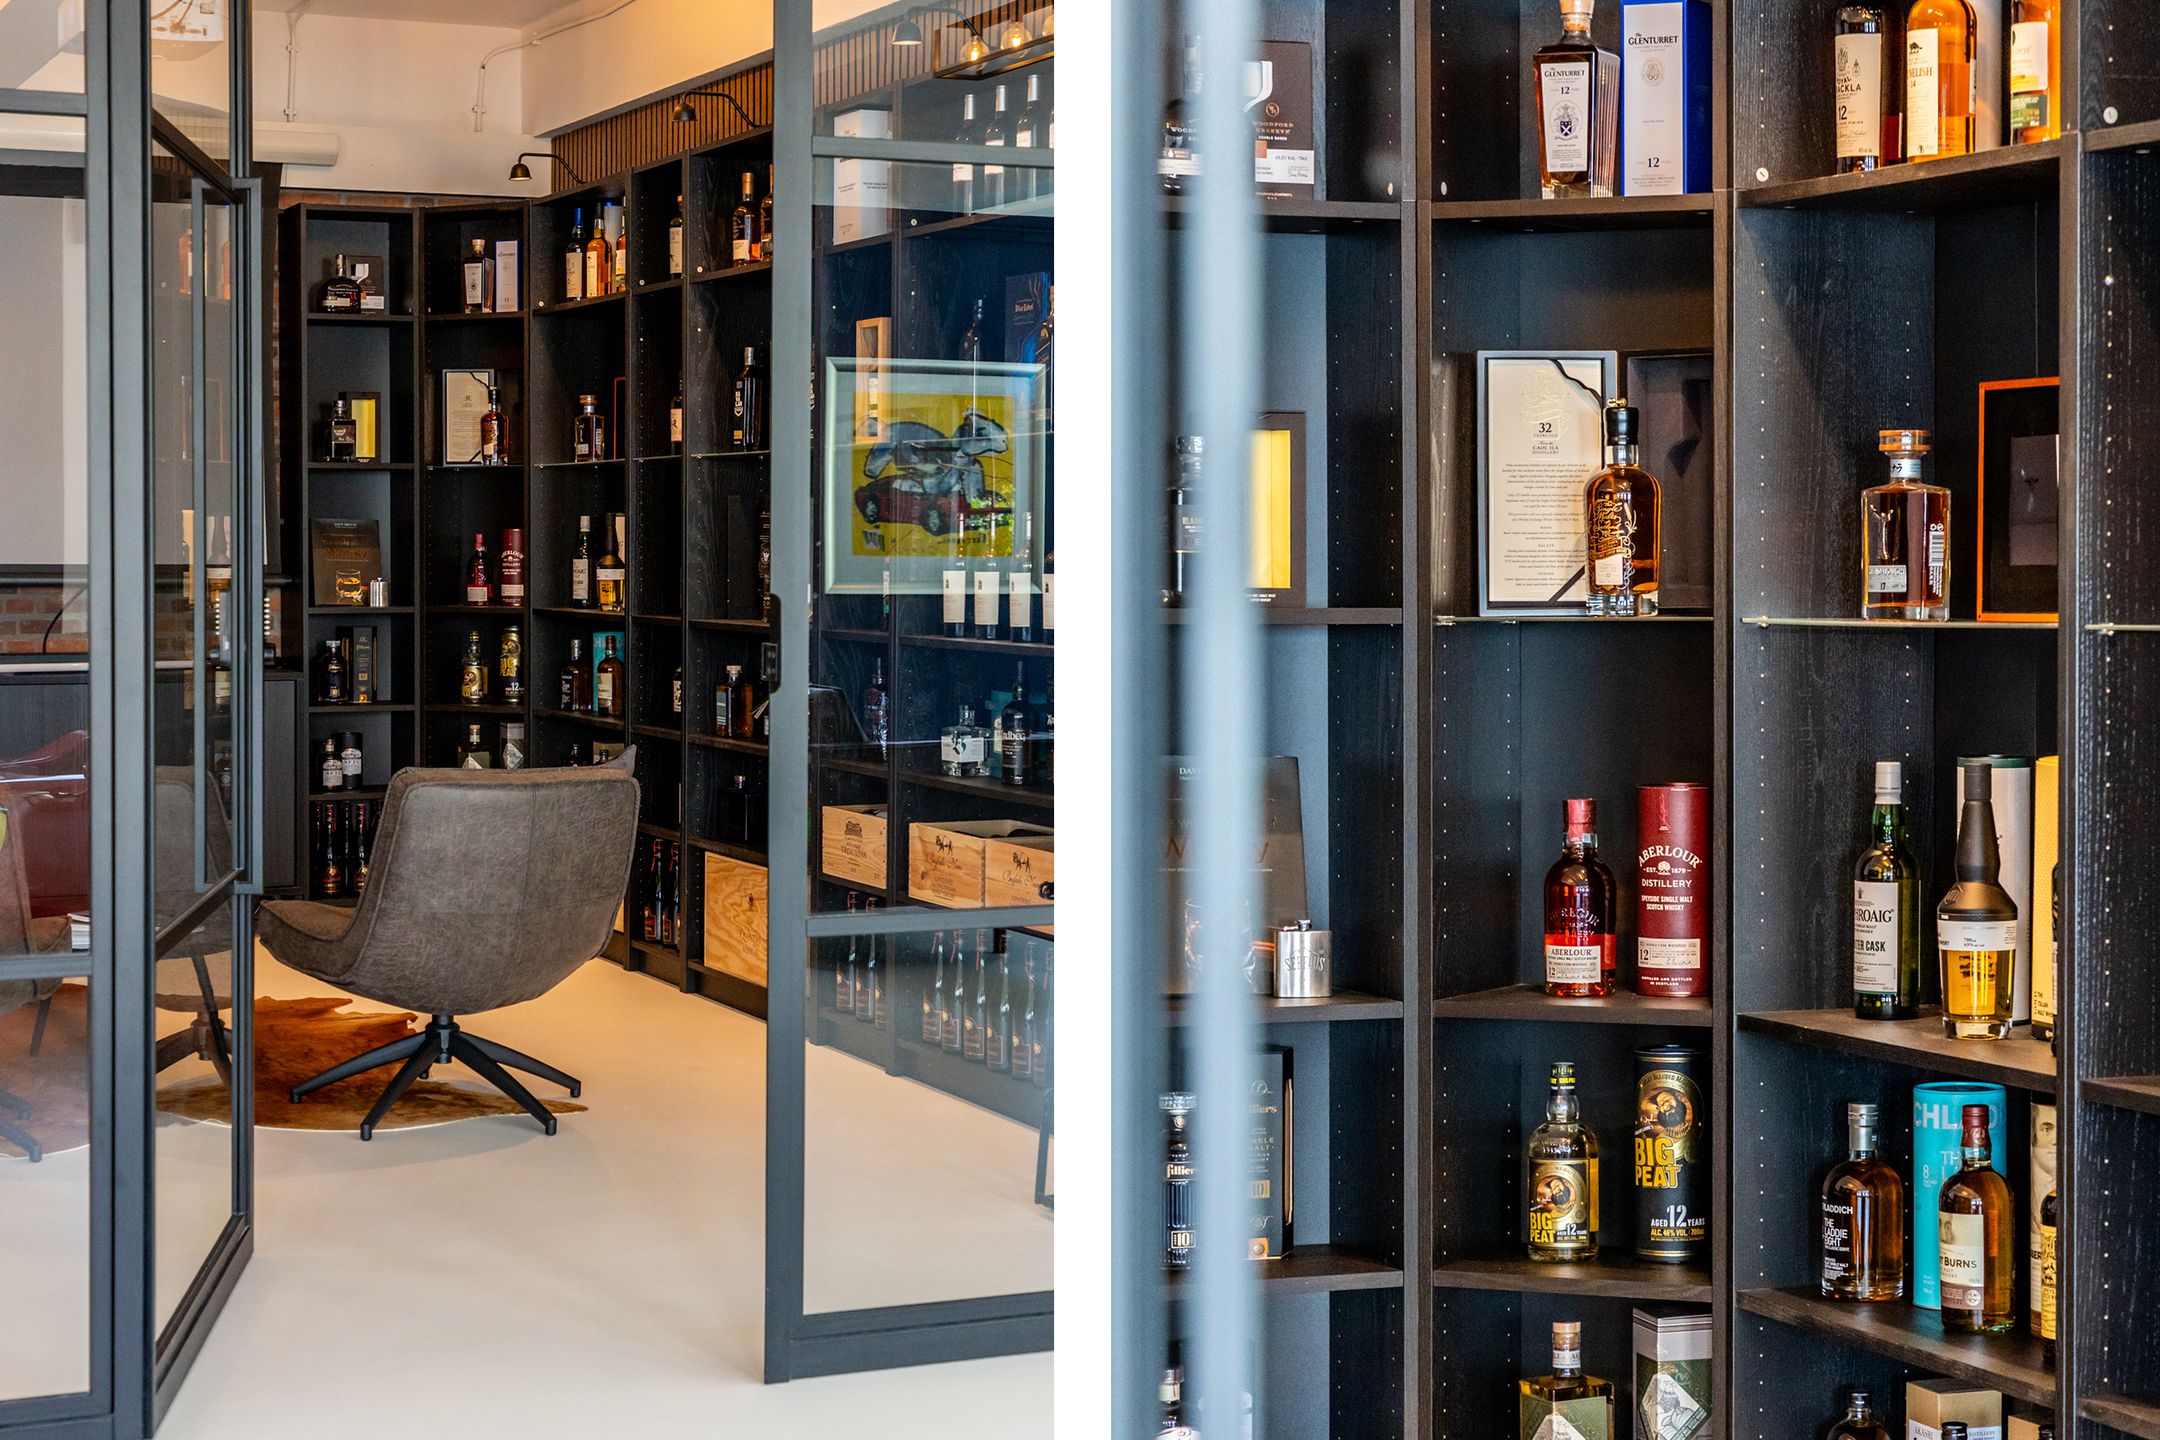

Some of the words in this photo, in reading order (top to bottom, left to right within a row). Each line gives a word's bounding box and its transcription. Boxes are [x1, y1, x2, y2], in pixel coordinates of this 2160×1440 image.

[1628, 35, 1679, 46] GLENTURRET
[1544, 70, 1585, 78] GLENTURRET
[1560, 86, 1570, 95] 12
[1647, 156, 1660, 168] 12
[1538, 422, 1552, 433] 32
[1638, 845, 1700, 869] ABERLOUR
[1641, 878, 1692, 888] DISTILLERY
[1551, 948, 1592, 956] ABERLOUR
[1865, 940, 1886, 952] CASK
[1640, 949, 1649, 961] 12
[1548, 966, 1556, 976] 12
[1635, 1137, 1675, 1167] BIG
[1166, 1164, 1196, 1178] fillier
[1635, 1165, 1680, 1188] PEAT
[1922, 1164, 1930, 1179] 8
[1530, 1212, 1553, 1230] BIG
[1651, 1218, 1668, 1227] AGED
[1667, 1204, 1687, 1228] 12
[1687, 1217, 1705, 1227] YEARS
[1824, 1217, 1834, 1228] THE
[1565, 1223, 1577, 1236] 12
[1651, 1228, 1663, 1237] ALC.
[1676, 1228, 1688, 1237] VOL.
[1824, 1227, 1848, 1239] LADDIE
[1177, 1232, 1190, 1247] 10
[1530, 1229, 1556, 1243] PEAT
[1824, 1236, 1842, 1247] EIGHT
[1944, 1256, 1978, 1269] BURNS
